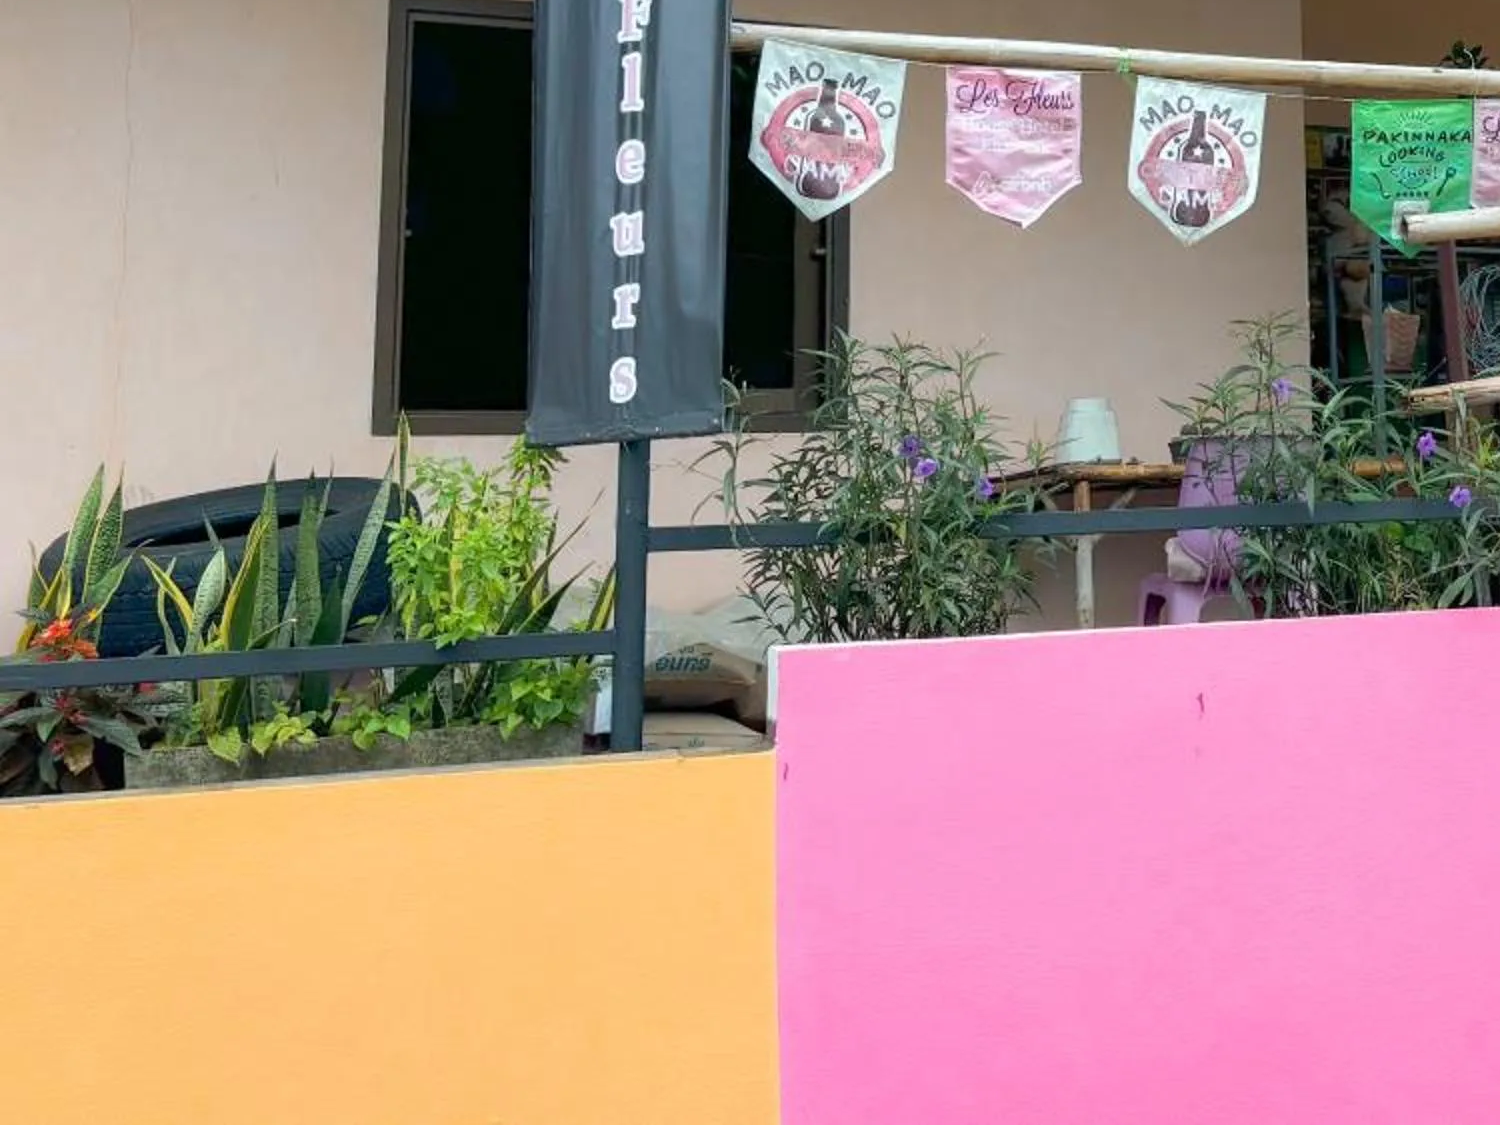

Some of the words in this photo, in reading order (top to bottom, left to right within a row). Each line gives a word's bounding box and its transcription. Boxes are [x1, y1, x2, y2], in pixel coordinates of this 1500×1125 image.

[764, 61, 826, 98] MAO
[841, 71, 897, 120] MAO
[955, 78, 1001, 113] Les
[1005, 79, 1075, 116] Fleurs
[1139, 95, 1195, 132] MAO
[1209, 103, 1258, 148] MAO
[1362, 130, 1472, 144] PAKINNAKA
